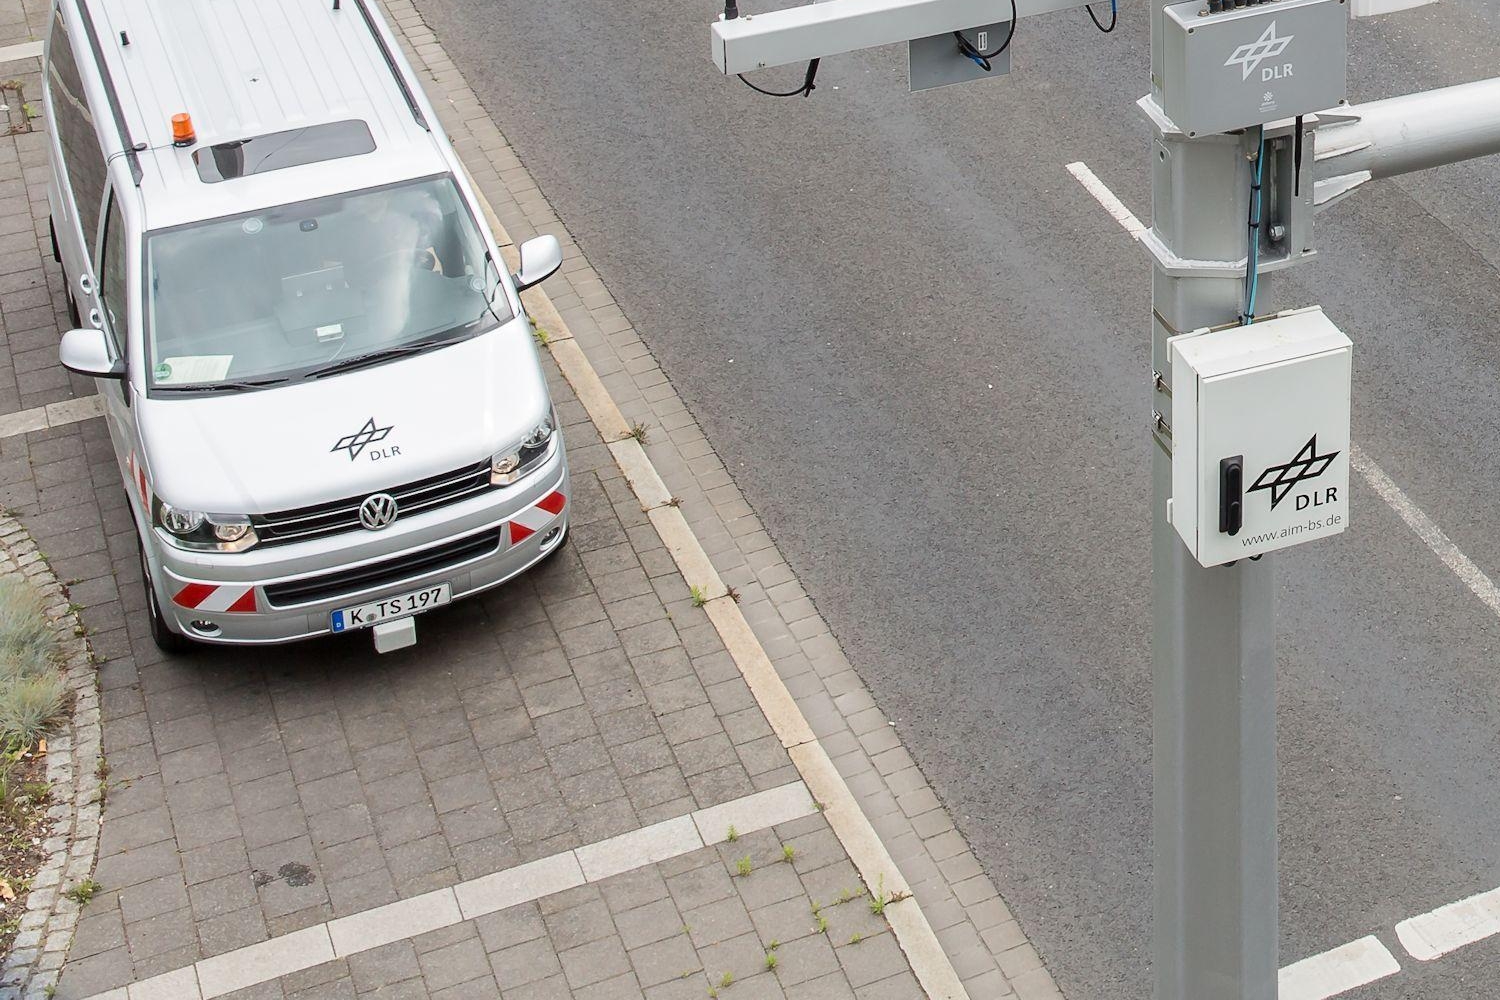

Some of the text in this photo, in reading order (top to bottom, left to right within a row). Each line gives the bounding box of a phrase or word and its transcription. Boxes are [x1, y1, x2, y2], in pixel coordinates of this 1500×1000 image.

[1261, 63, 1294, 82] DLR
[370, 446, 402, 461] DLR
[1295, 487, 1338, 511] DLR
[1241, 514, 1341, 547] www.aim-bs.de
[351, 608, 363, 625] K
[376, 598, 402, 617] TS
[406, 588, 442, 610] 197
